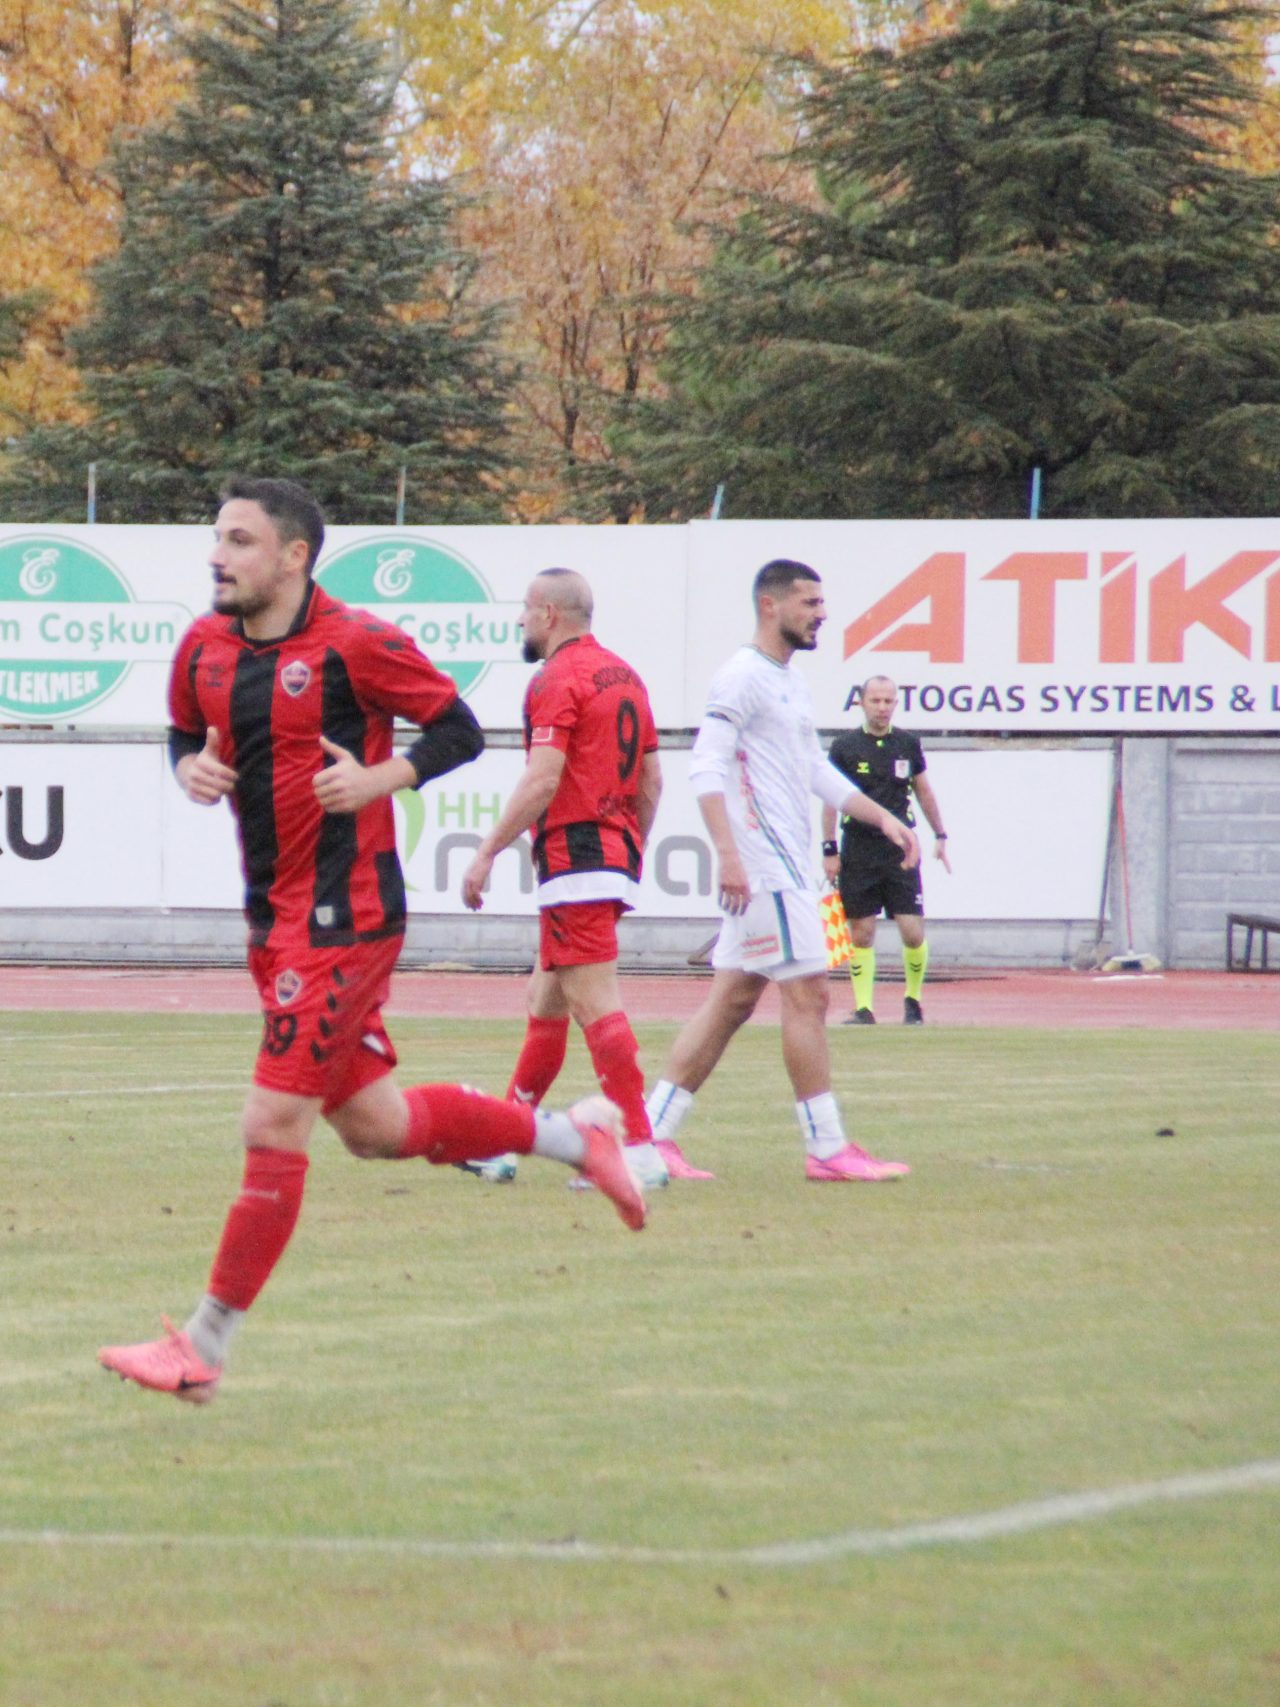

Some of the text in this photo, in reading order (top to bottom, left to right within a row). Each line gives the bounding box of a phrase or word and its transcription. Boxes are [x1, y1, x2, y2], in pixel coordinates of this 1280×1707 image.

[38, 613, 174, 651] Coşkun
[843, 684, 1026, 713] ATOGAS
[1040, 684, 1215, 713] SYSTEMS
[1229, 684, 1256, 713] &
[617, 696, 640, 780] 9
